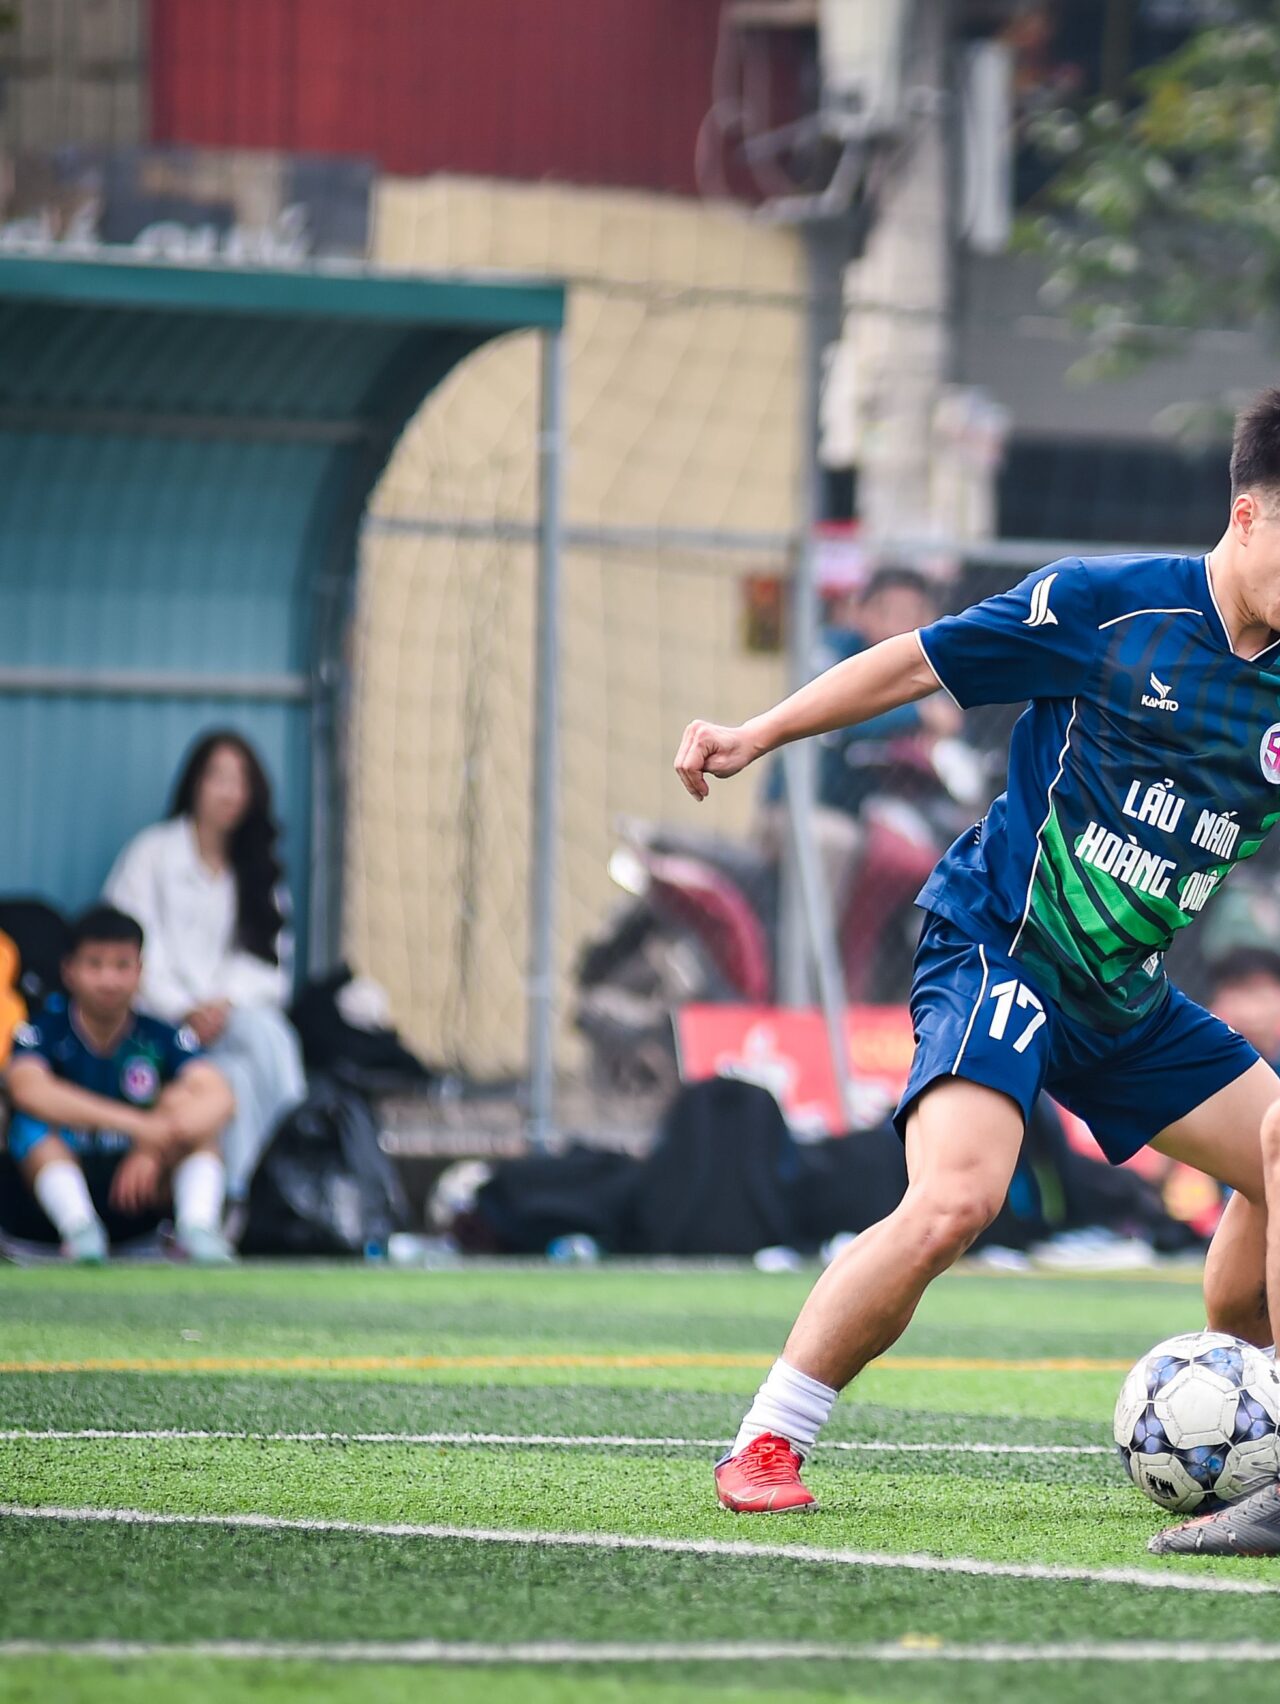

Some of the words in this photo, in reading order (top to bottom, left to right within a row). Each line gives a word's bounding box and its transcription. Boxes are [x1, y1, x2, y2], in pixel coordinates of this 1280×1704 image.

[1141, 694, 1179, 712] KAMITO
[1122, 778, 1186, 833] LẨU
[1190, 808, 1241, 860] NẤM
[1074, 821, 1177, 899] HOÀNG
[1179, 869, 1221, 912] QUÂ
[988, 979, 1047, 1054] 17
